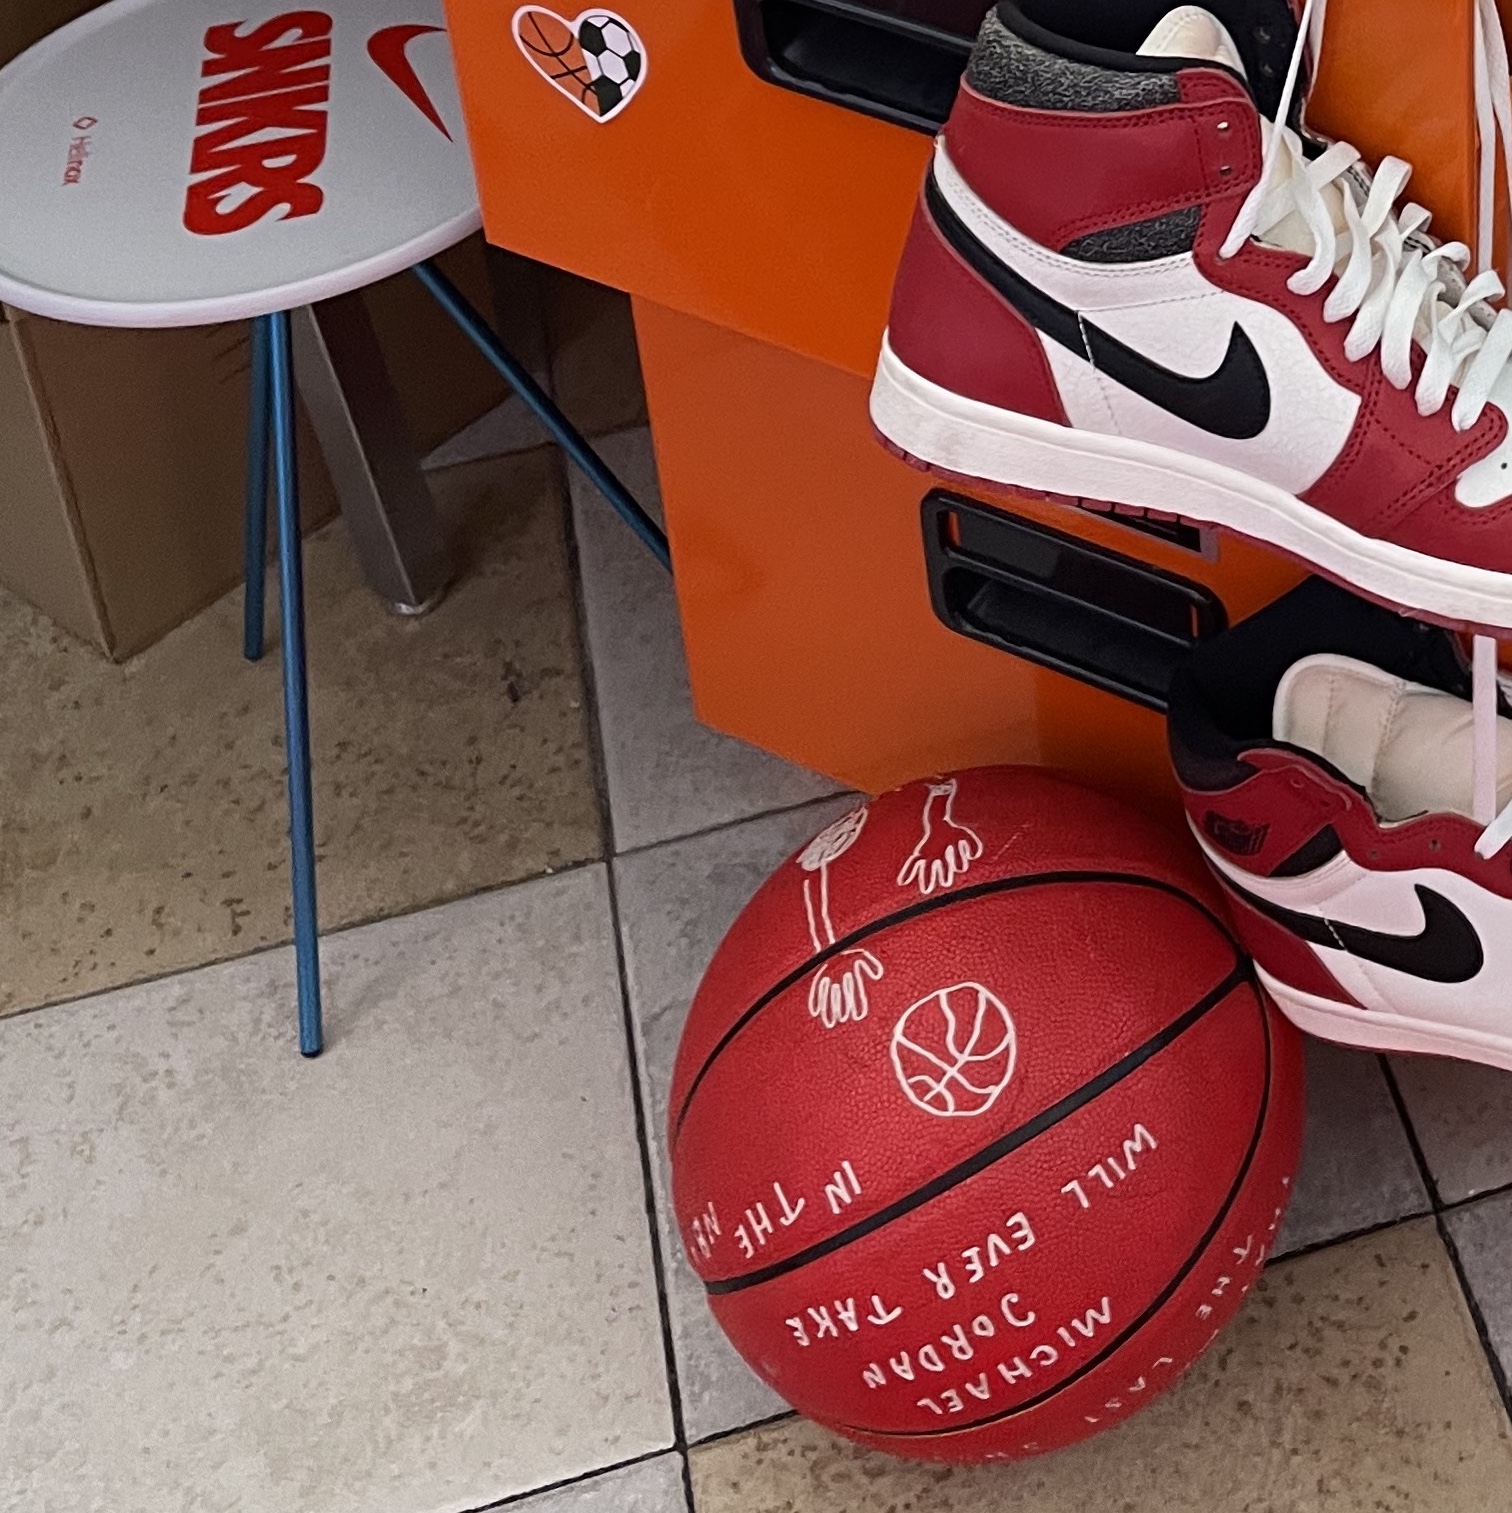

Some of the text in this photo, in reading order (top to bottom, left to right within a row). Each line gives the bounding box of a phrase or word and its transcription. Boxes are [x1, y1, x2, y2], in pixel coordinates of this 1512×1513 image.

[183, 10, 333, 236] SNKRS
[734, 1181, 806, 1259] THE
[785, 1122, 1159, 1347] WILL EVER TAKE
[824, 1160, 863, 1216] IN
[862, 1291, 1037, 1391] JORDAN
[915, 1296, 1114, 1418] MICHAEL
